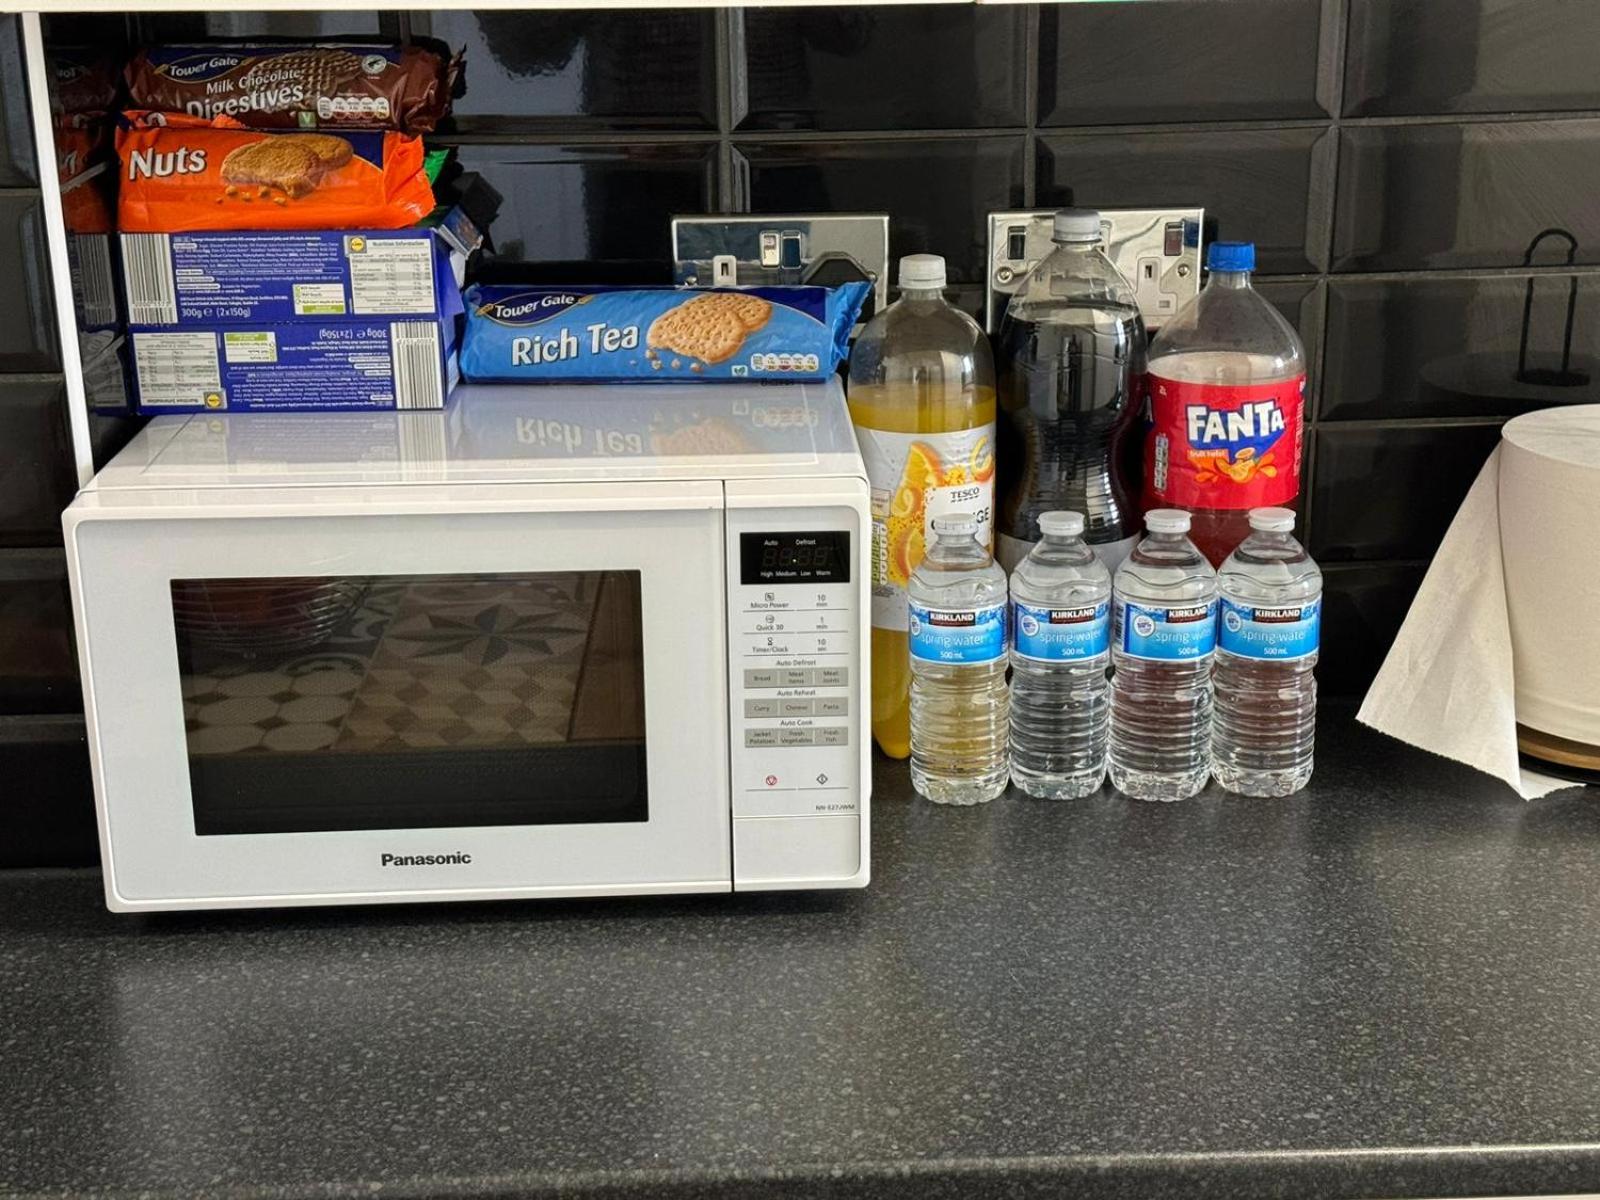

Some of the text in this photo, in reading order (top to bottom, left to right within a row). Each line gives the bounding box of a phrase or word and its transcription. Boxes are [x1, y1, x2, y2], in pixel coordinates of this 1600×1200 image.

[170, 57, 239, 77] Tower Gate
[206, 69, 302, 95] Milk Chocolate
[186, 85, 304, 119] Digestives
[128, 147, 208, 180] Nuts
[495, 293, 575, 318] Tower Gate
[182, 308, 202, 318] 300g
[511, 323, 640, 366] Rich Tea
[950, 487, 980, 498] TESCO
[930, 612, 974, 621] KIRKLAND
[1051, 609, 1095, 619] KIRKLAND
[1168, 607, 1207, 617] KIRKLAND
[1255, 609, 1300, 618] KIRKLAND
[1040, 631, 1073, 644] spring
[1155, 631, 1190, 644] spring
[1278, 630, 1307, 642] wate
[381, 851, 472, 866] Panasonic
